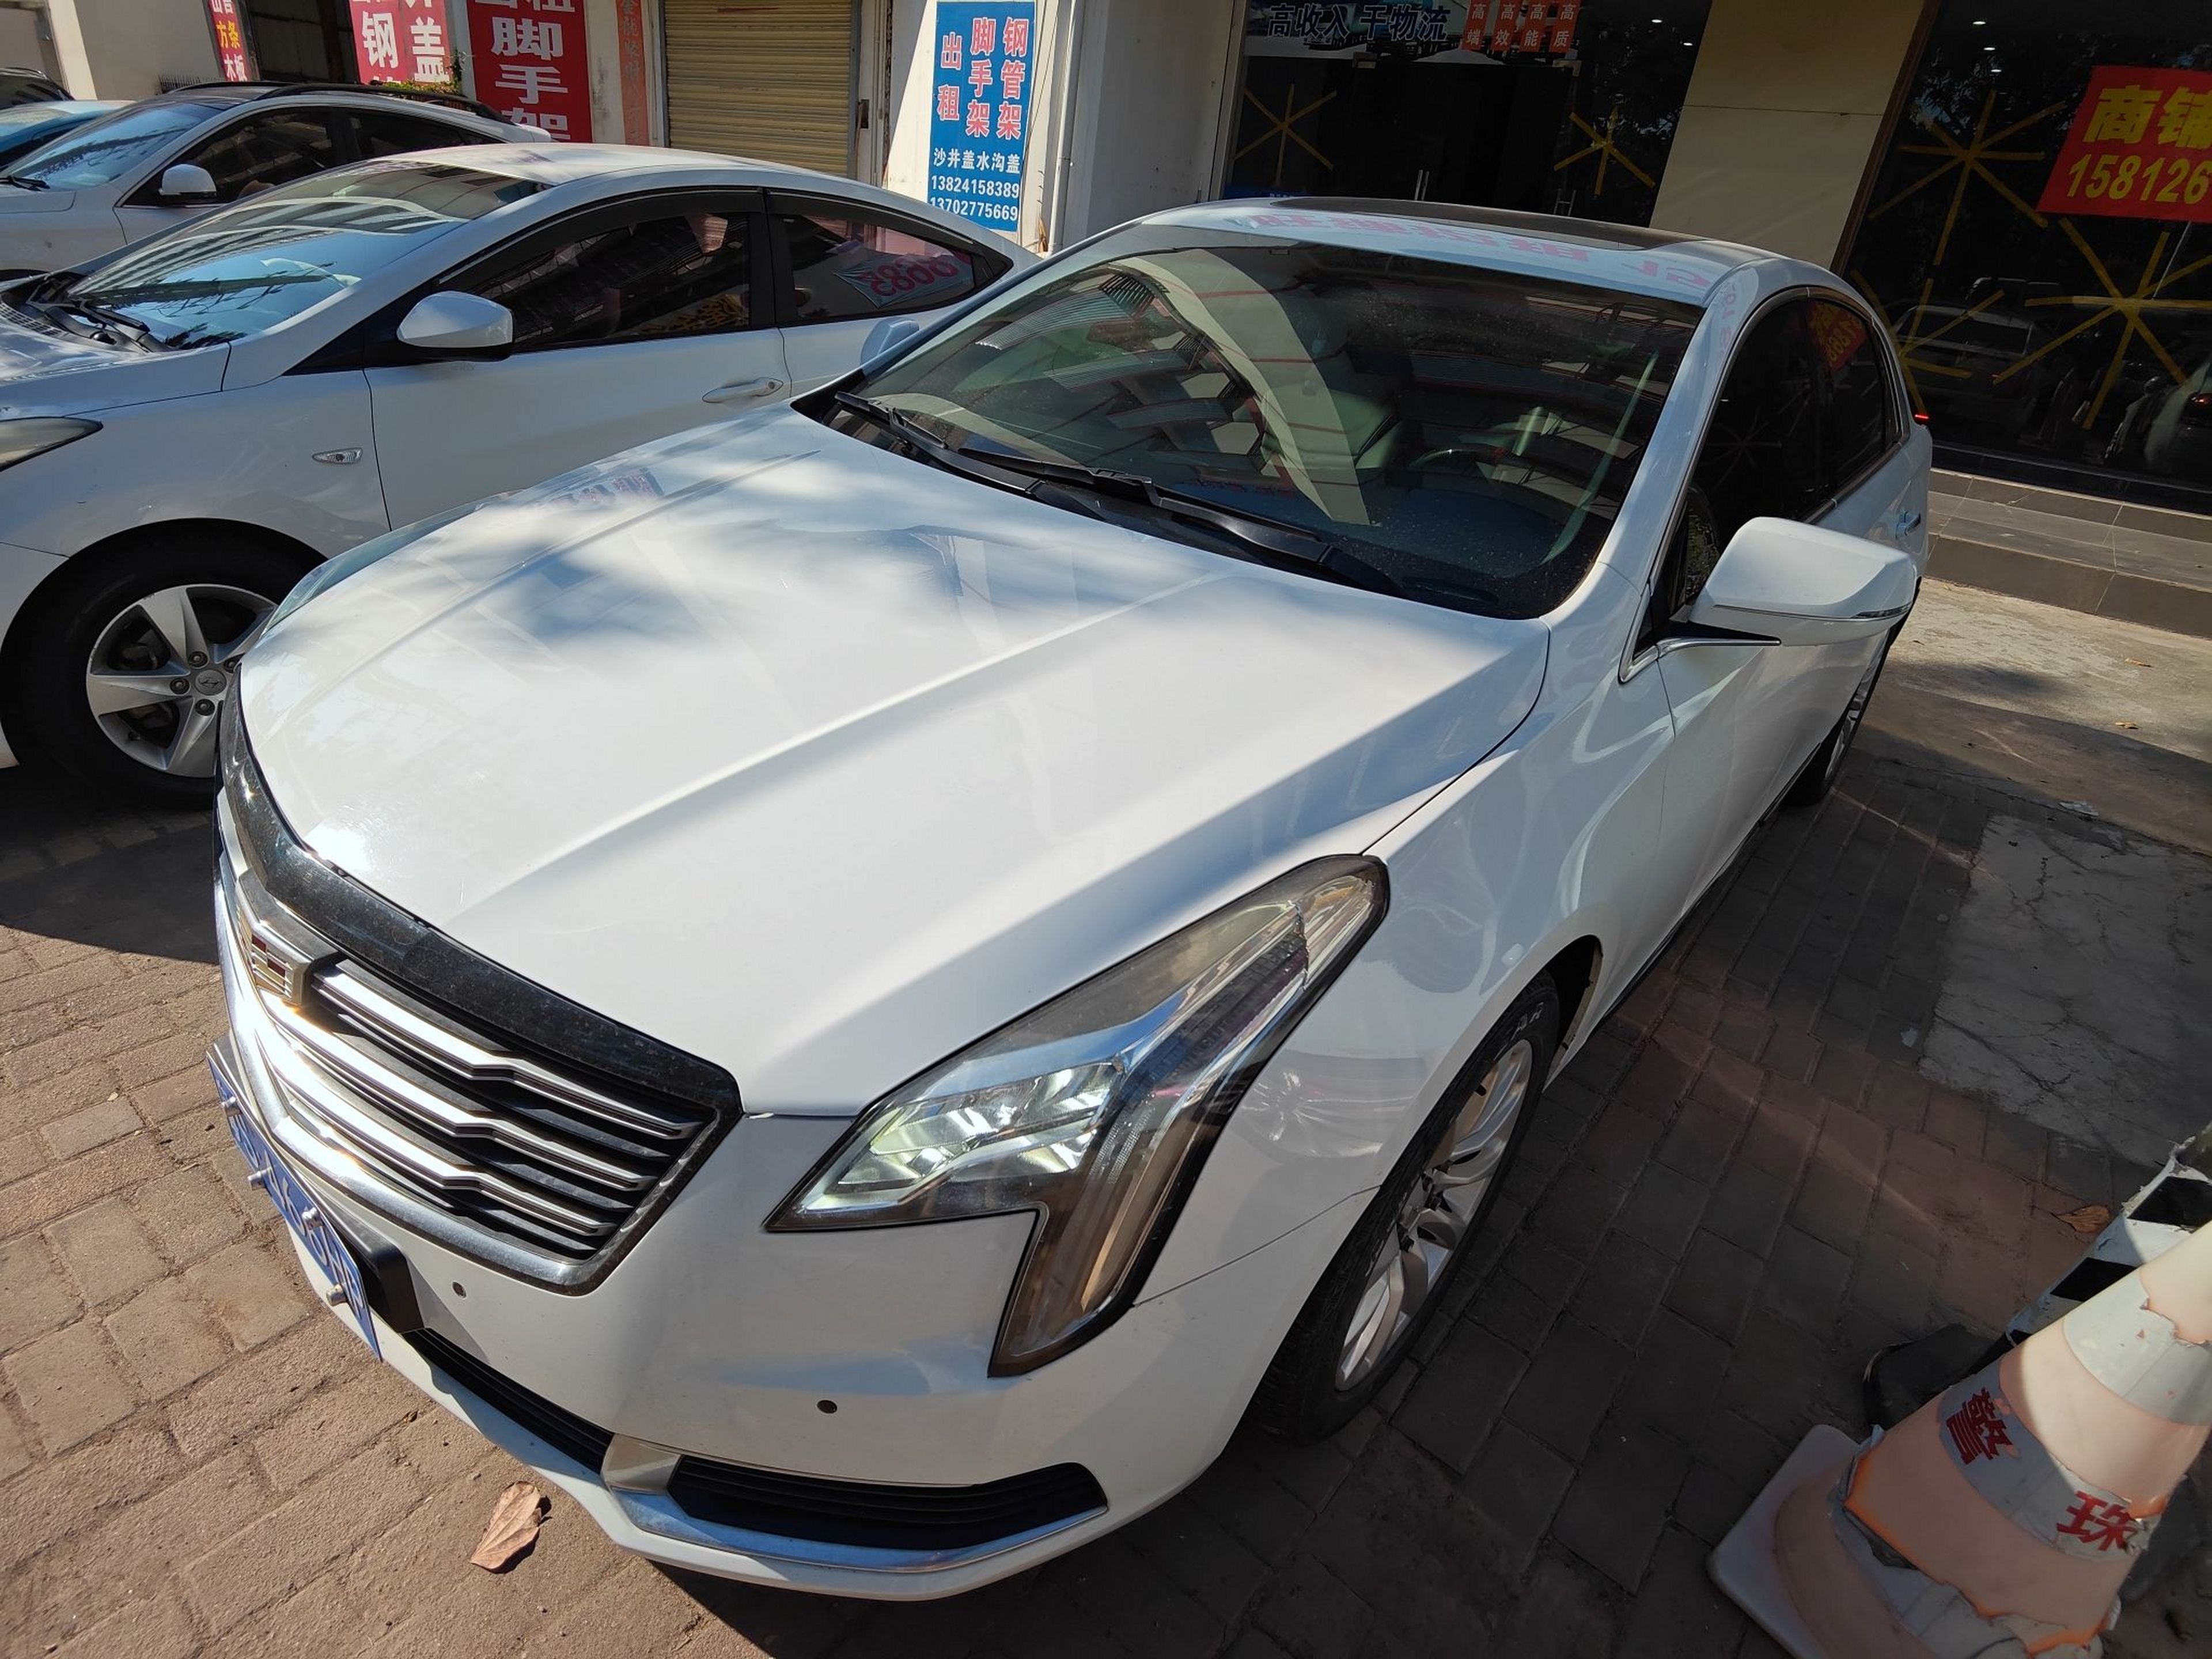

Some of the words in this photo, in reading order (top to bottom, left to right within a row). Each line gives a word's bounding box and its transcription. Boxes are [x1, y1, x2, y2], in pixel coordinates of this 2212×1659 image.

[407, 0, 450, 82] 盖
[1267, 2, 1350, 39] 高收入
[937, 32, 963, 121] 出租
[965, 17, 997, 138] 脚手架
[997, 16, 1029, 140] 钢管架
[931, 175, 1020, 199] 13824158389
[933, 147, 1021, 173] 沙井盖水沟盖
[2066, 153, 2212, 204] 158126
[930, 196, 1018, 221] 13702775669
[1946, 1388, 2013, 1465] 警
